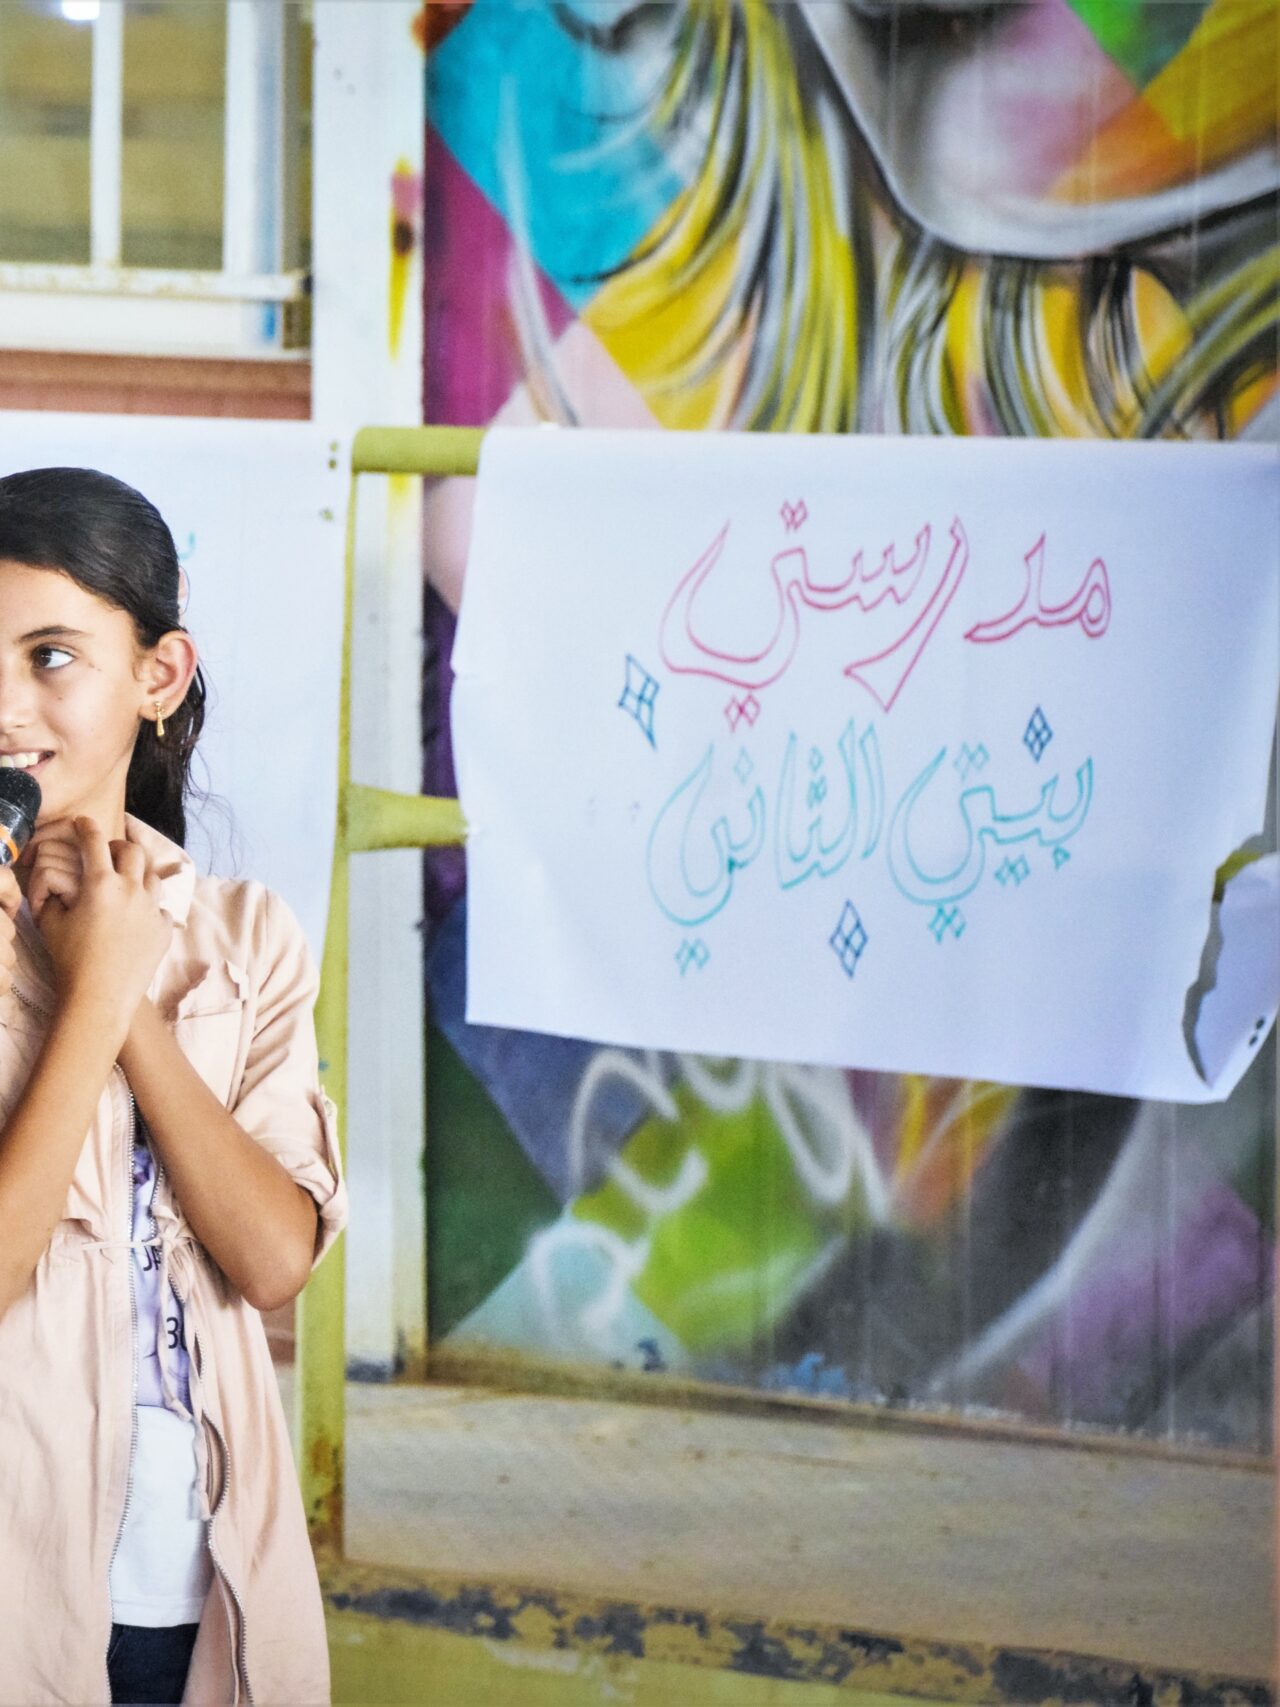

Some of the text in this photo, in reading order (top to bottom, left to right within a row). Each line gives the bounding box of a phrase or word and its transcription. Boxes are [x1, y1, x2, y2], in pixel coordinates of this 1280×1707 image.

[658, 498, 1113, 735] مدرستي
[646, 716, 1093, 979] بيتي الثاني
